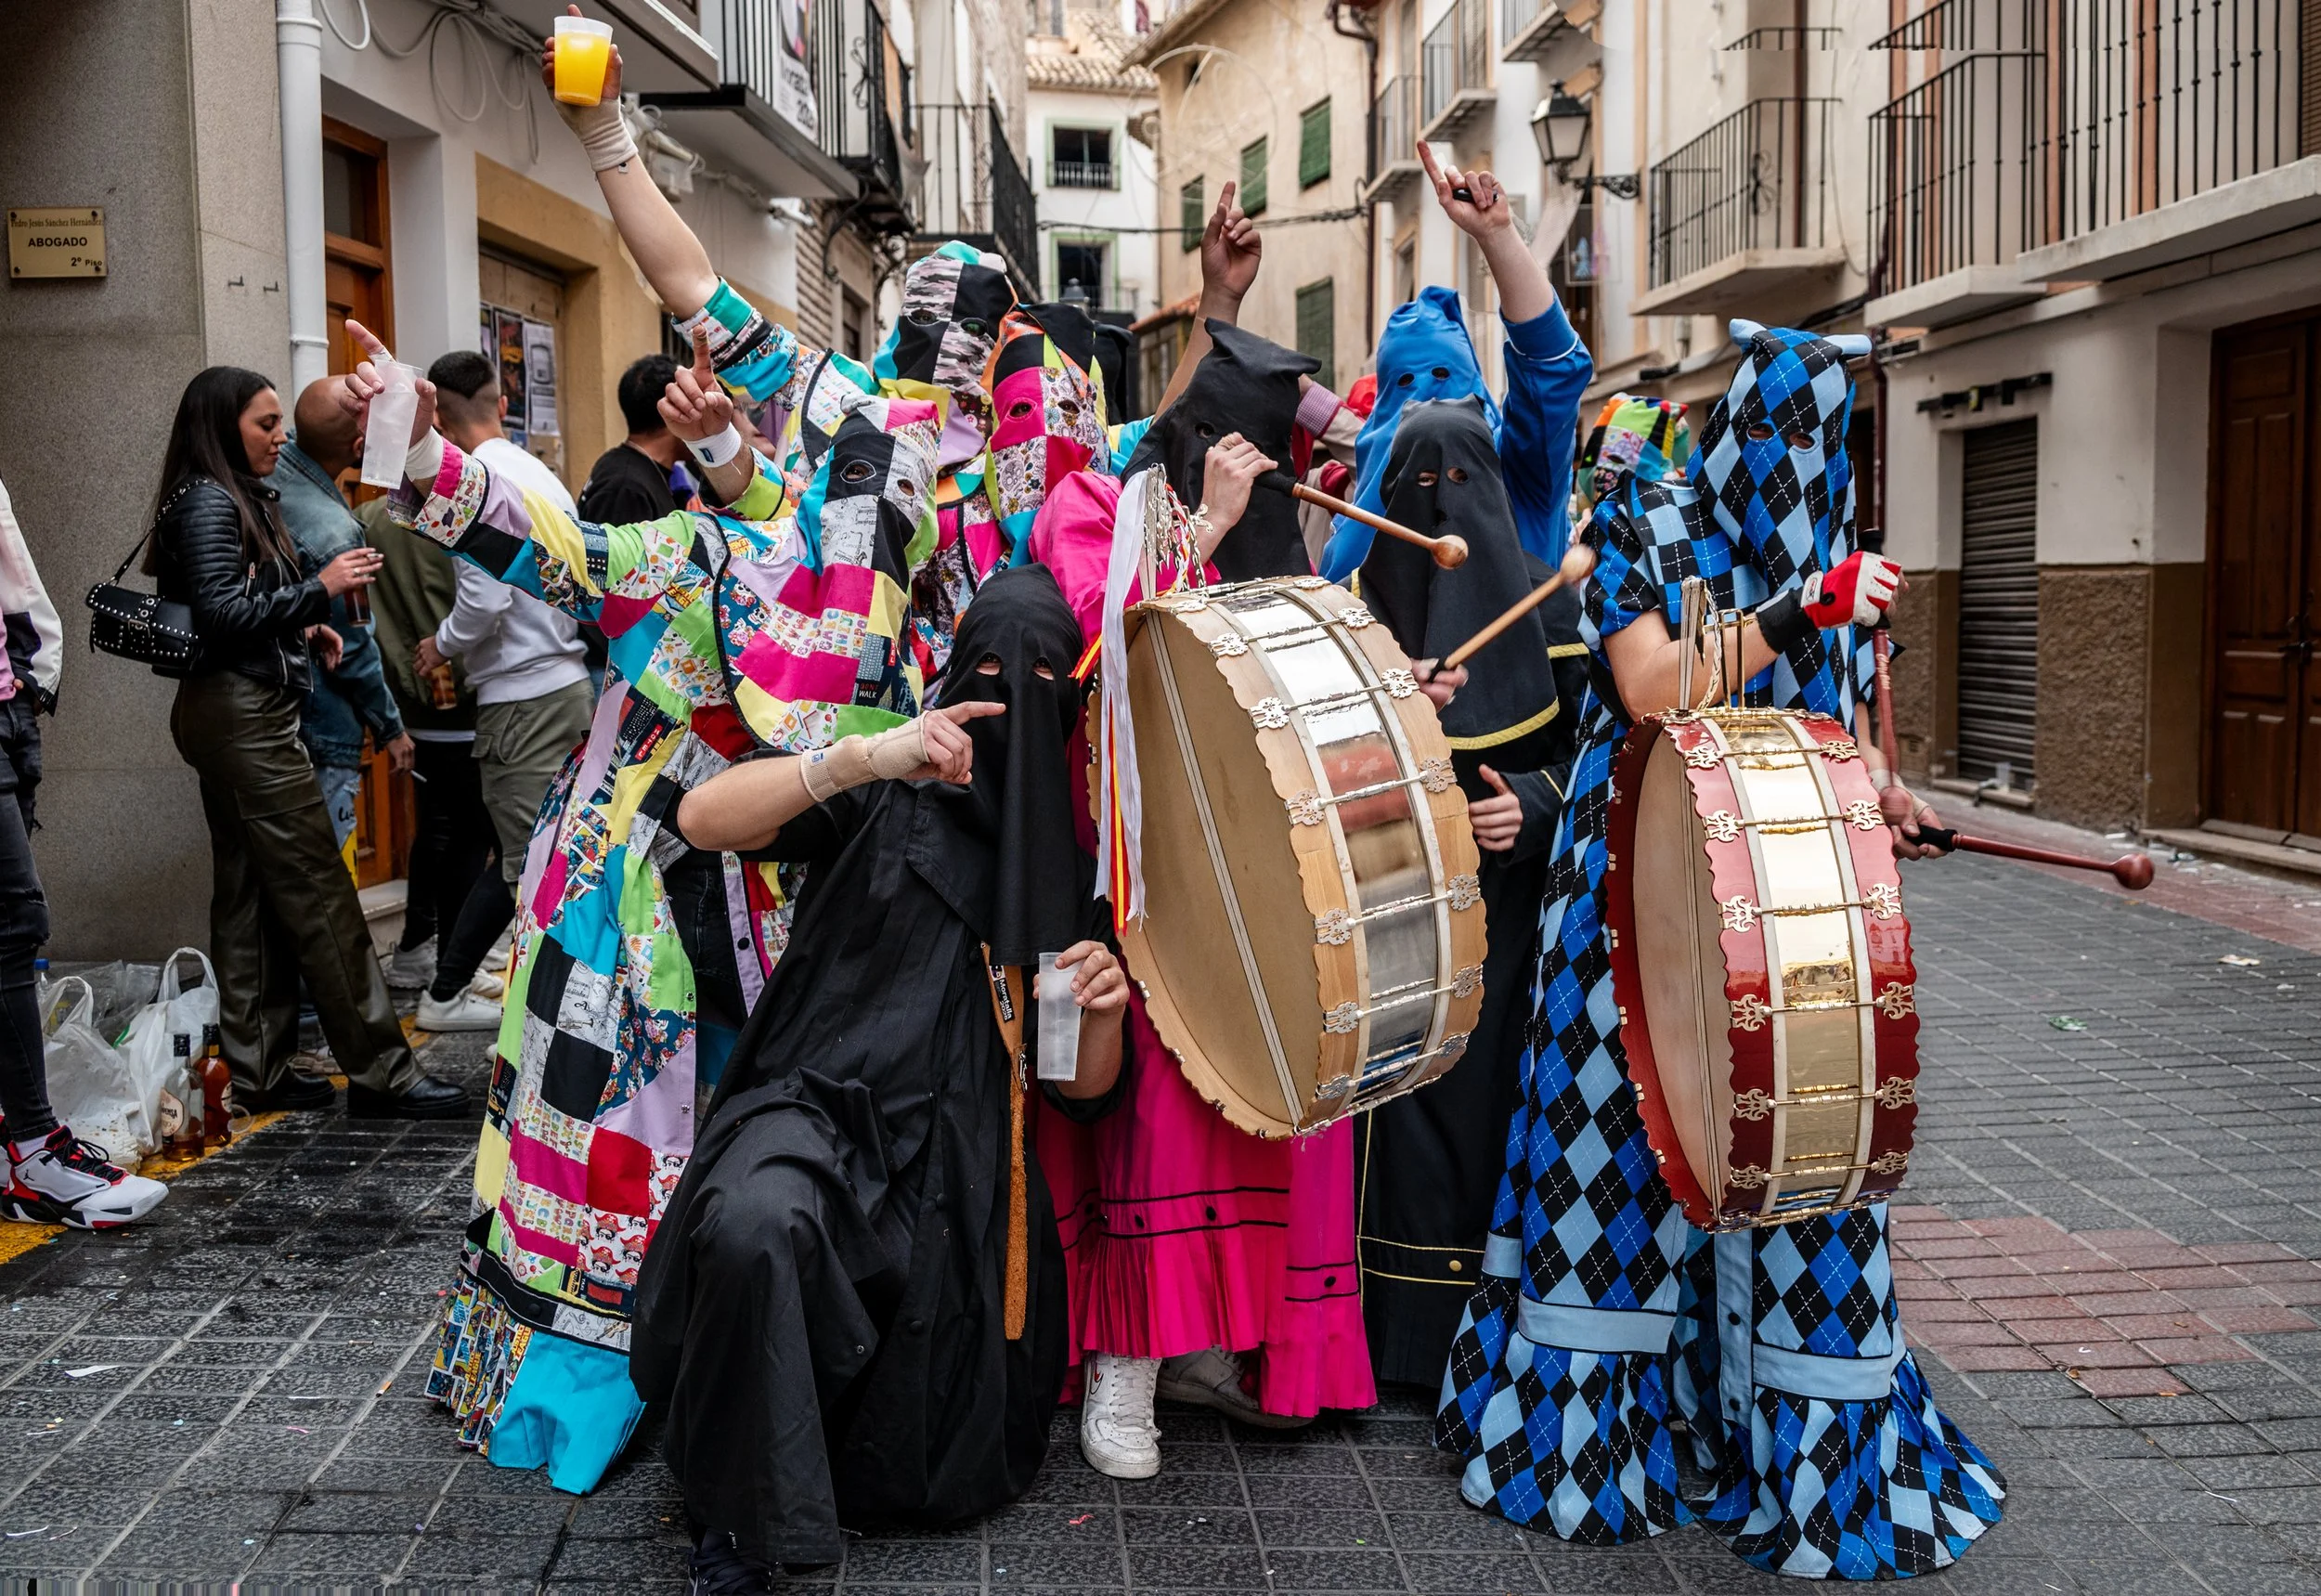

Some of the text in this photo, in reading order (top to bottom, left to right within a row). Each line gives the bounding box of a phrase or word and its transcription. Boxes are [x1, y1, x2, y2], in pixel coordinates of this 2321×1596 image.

[29, 218, 44, 228] Jesús
[45, 218, 70, 227] Sánchez
[28, 237, 88, 247] ABOGADO
[859, 690, 877, 699] WALK
[637, 728, 661, 759] HOTEL
[999, 980, 1013, 1019] Moratalla
[512, 1324, 525, 1356] JUSTIC
